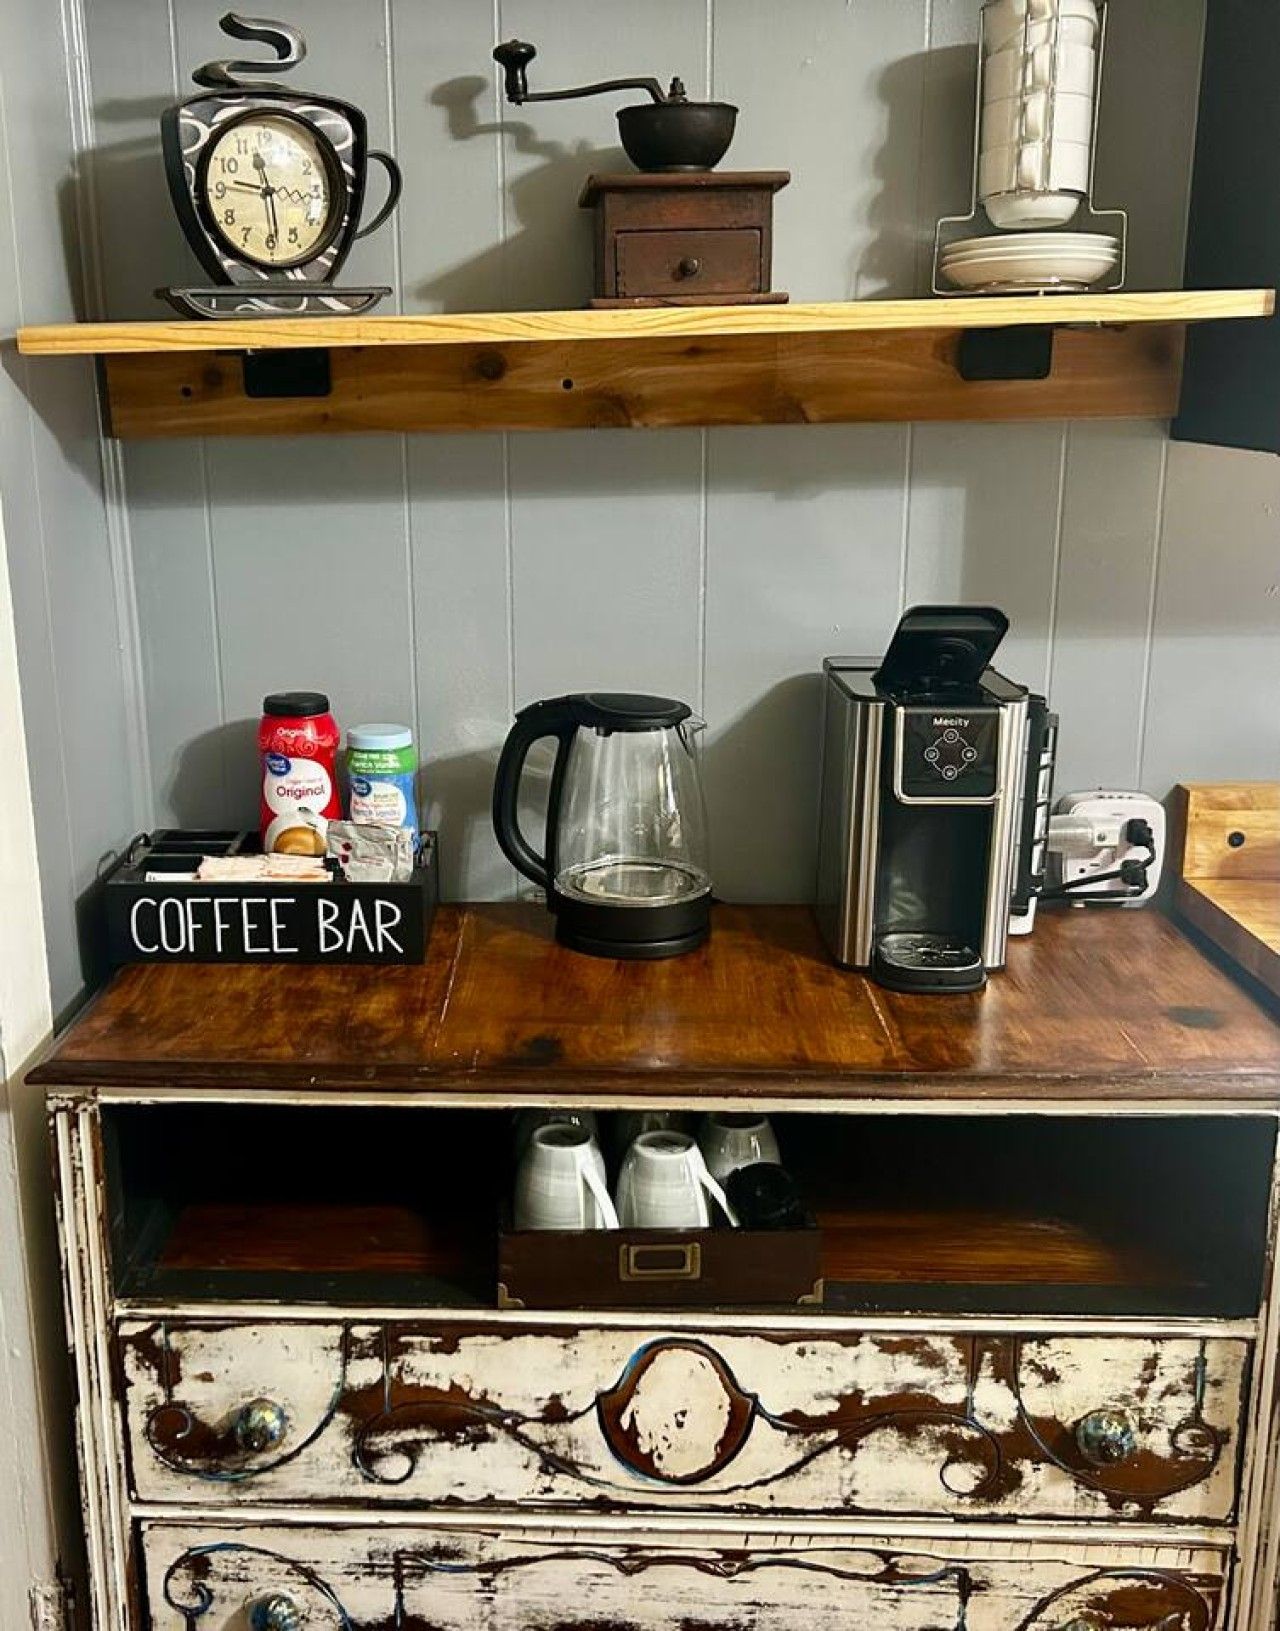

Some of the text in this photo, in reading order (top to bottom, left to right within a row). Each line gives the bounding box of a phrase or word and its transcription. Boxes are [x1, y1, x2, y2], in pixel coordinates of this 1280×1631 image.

[236, 139, 249, 155] 11
[220, 157, 239, 174] 10
[302, 159, 312, 176] 2
[215, 181, 227, 200] 9
[224, 208, 236, 226] 8
[240, 227, 253, 244] 7
[265, 233, 276, 250] 6
[287, 227, 299, 244] 5
[932, 716, 970, 728] Mecity
[276, 785, 325, 800] Original
[130, 898, 404, 953] COFFEE BAR
